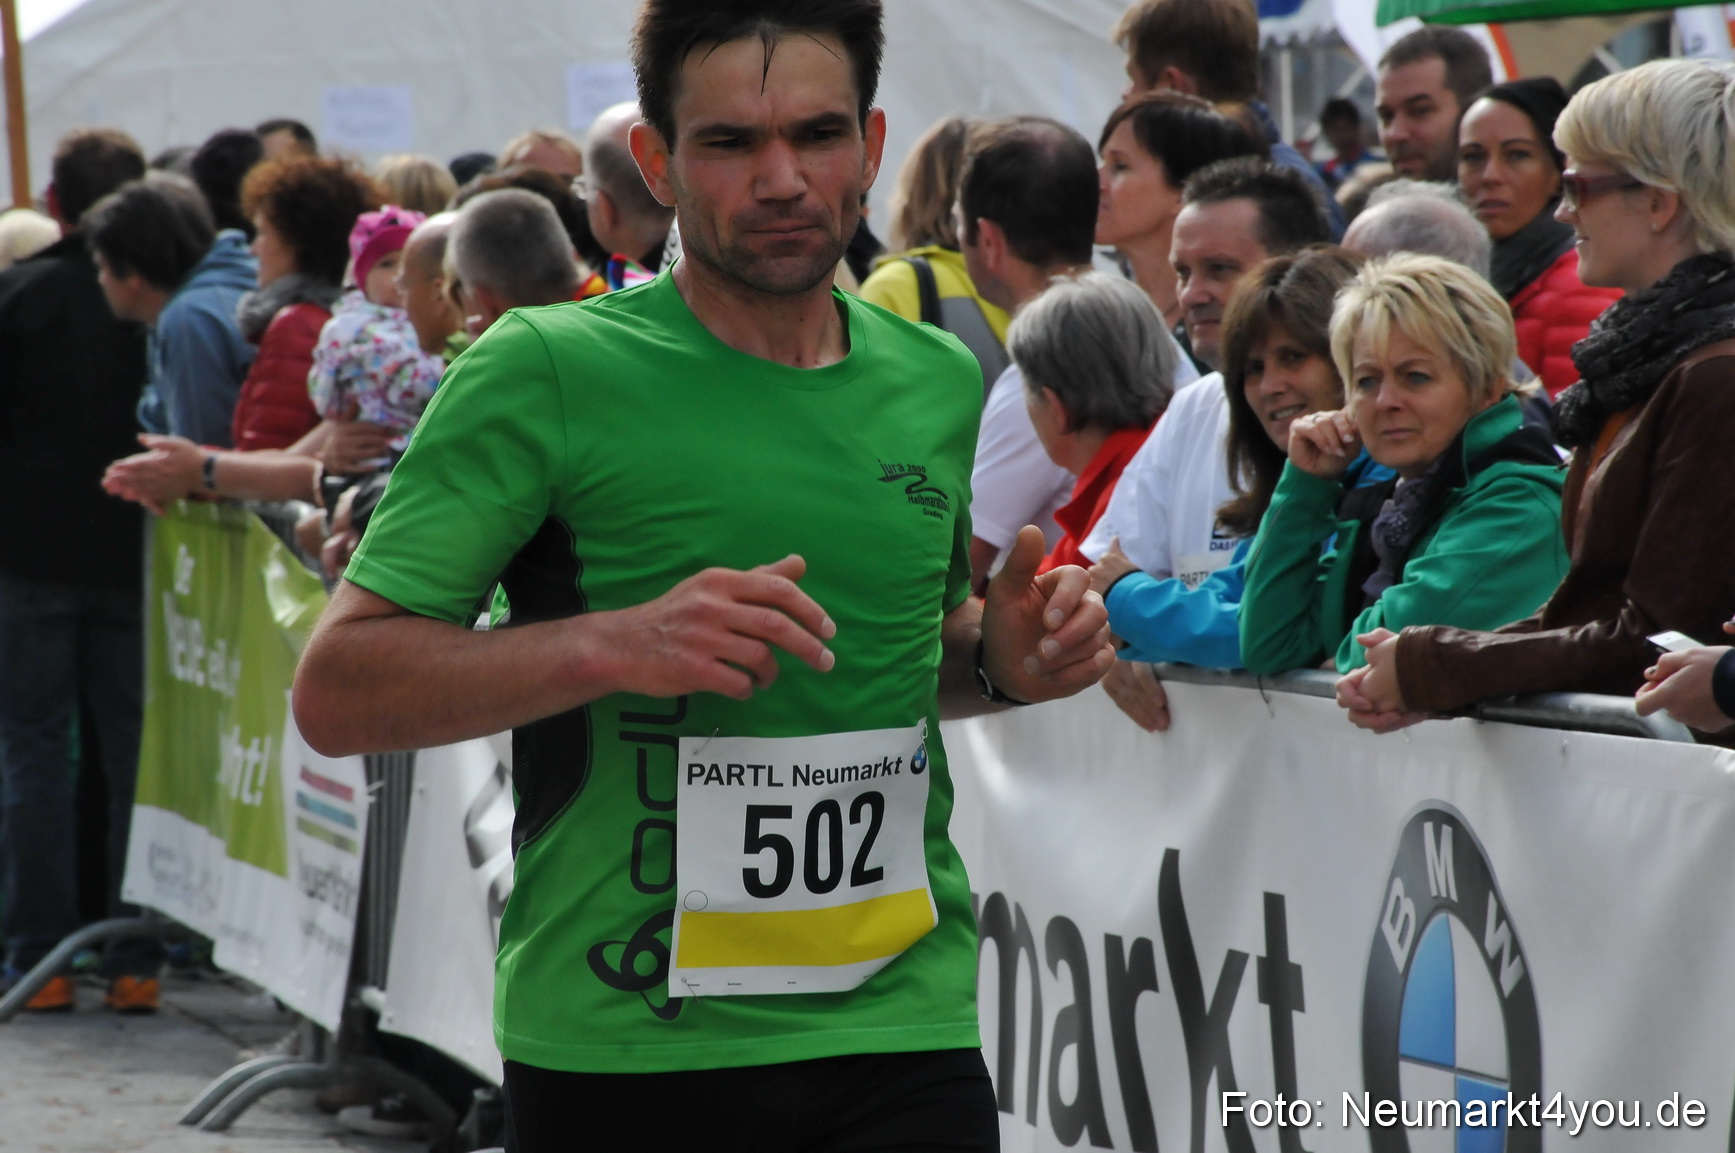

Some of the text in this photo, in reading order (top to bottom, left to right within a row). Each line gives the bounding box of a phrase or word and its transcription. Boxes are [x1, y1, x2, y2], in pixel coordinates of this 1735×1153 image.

[687, 756, 902, 787] PARTL Neumarkt
[742, 790, 885, 899] 502
[1381, 821, 1524, 999] BMW
